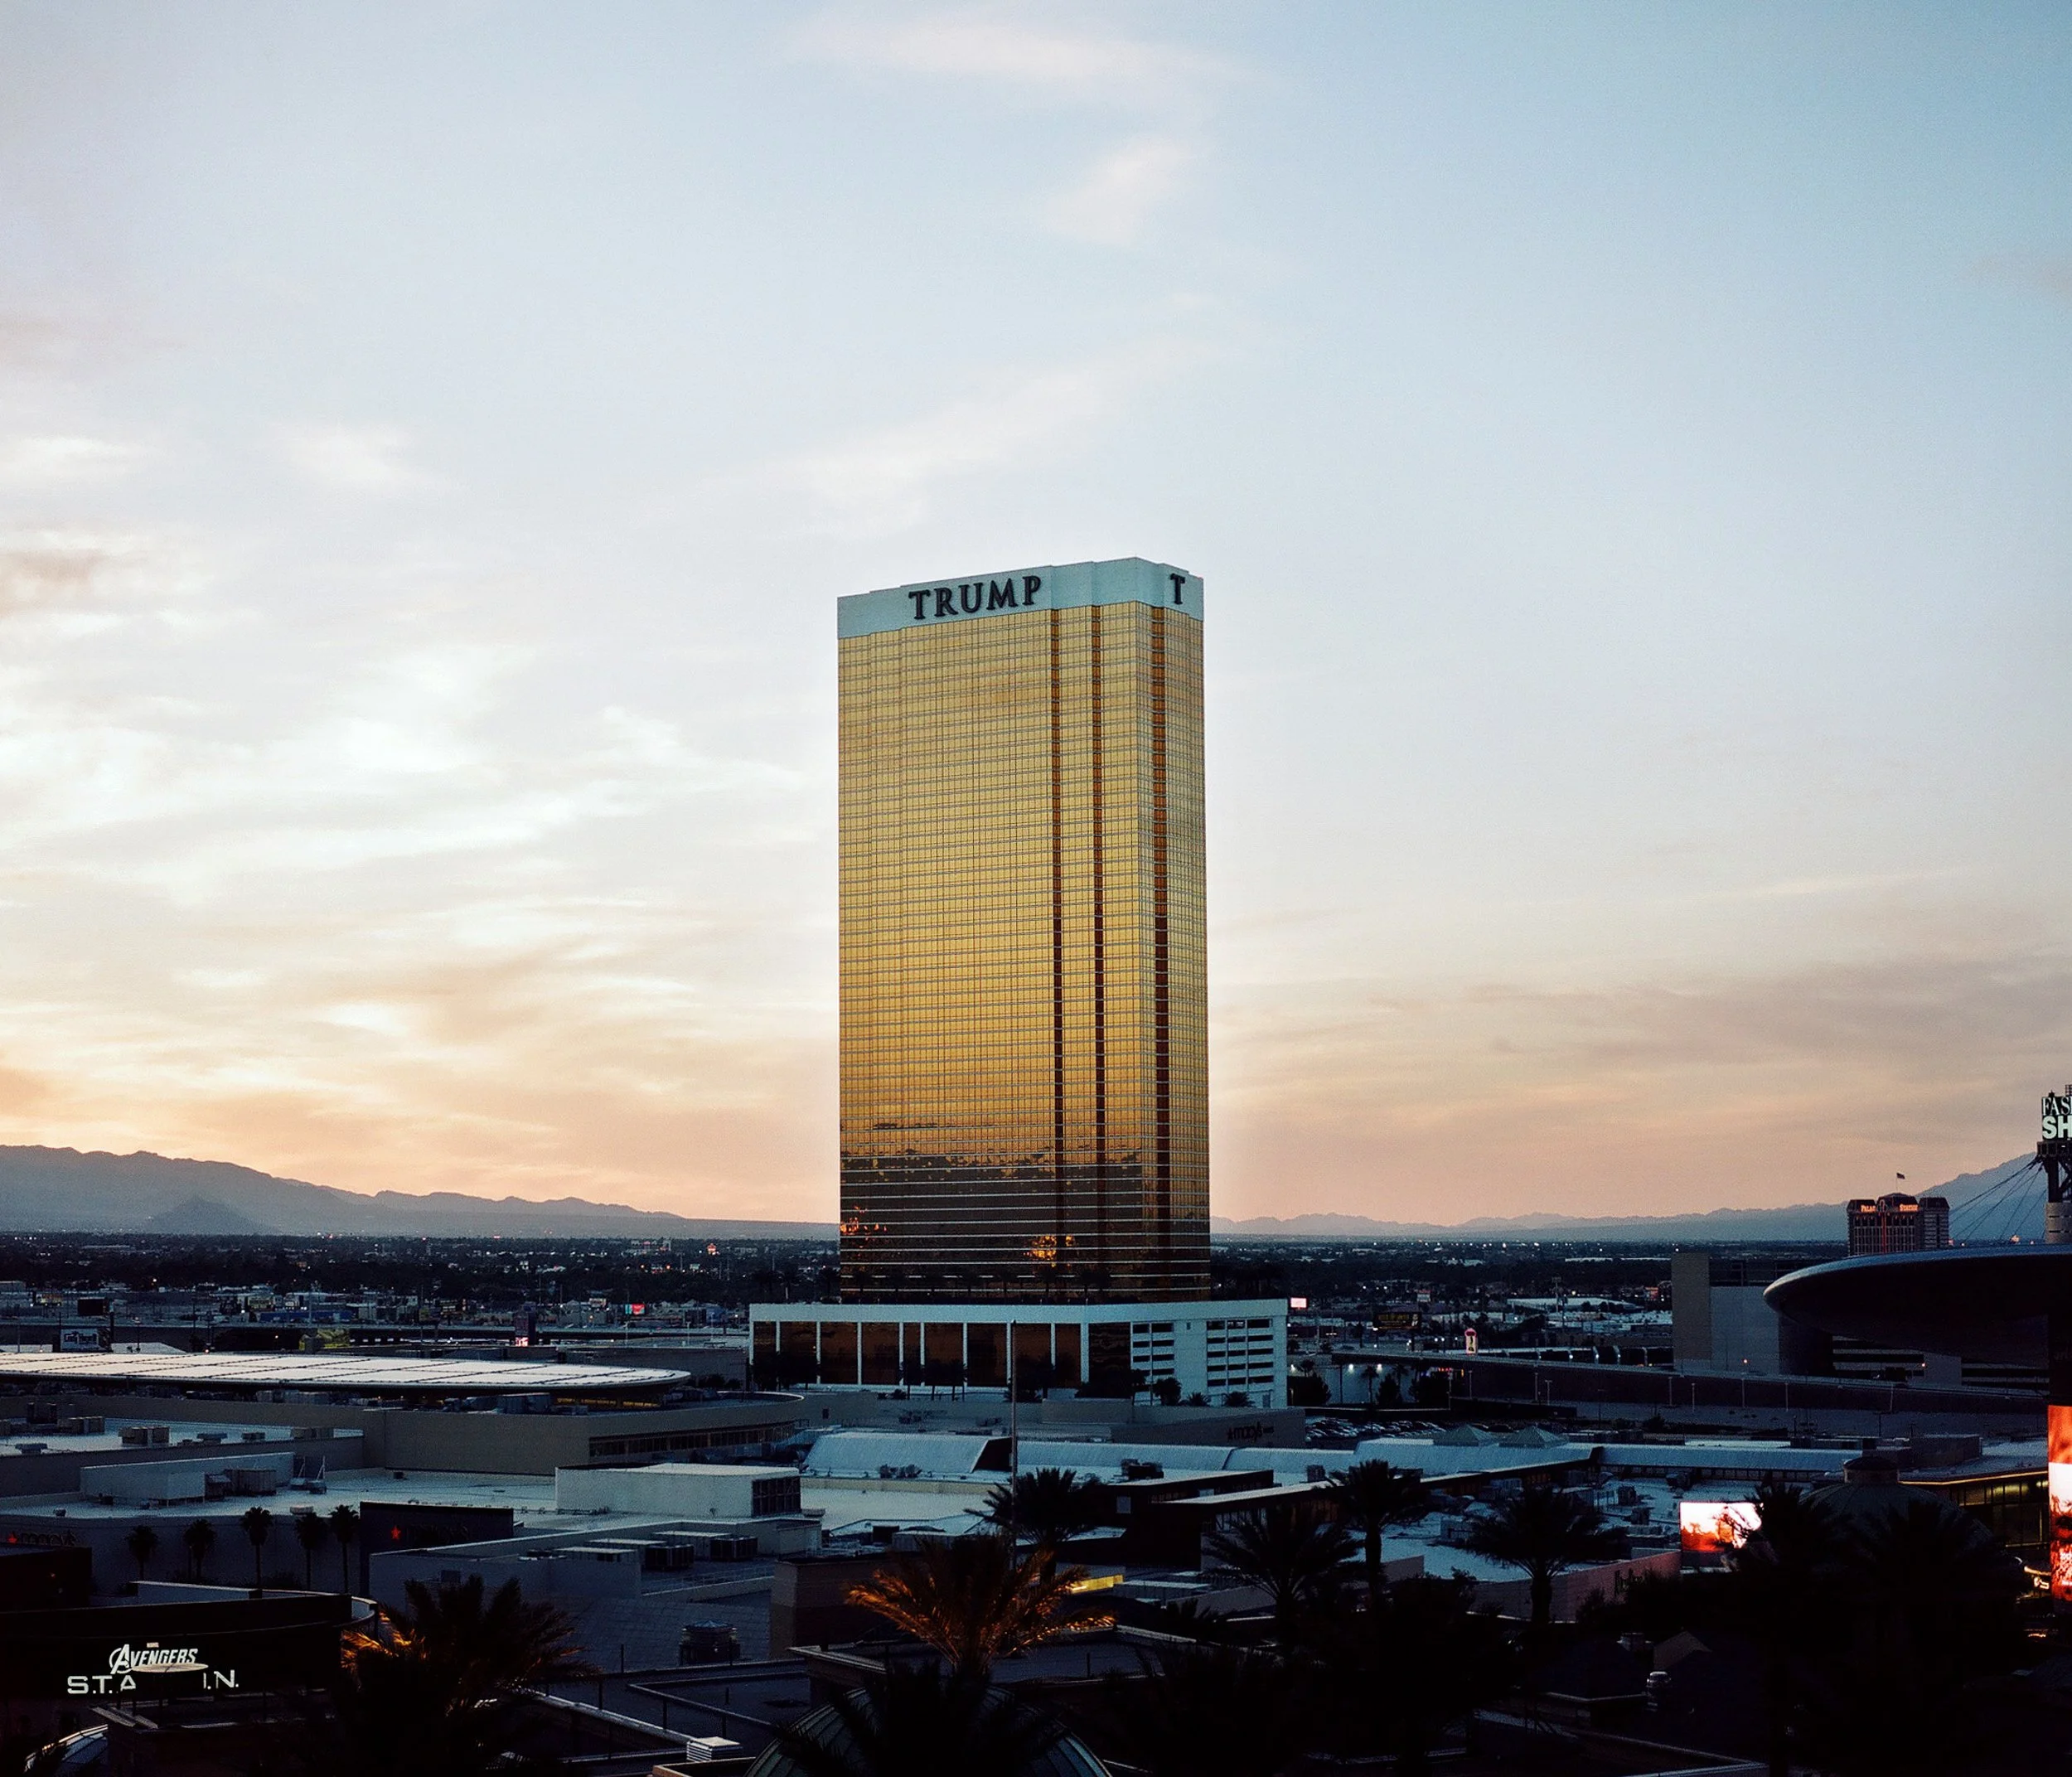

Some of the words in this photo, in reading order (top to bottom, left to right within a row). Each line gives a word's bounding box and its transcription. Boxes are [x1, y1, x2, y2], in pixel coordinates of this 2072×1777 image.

[908, 575, 1042, 620] TRUMP
[1170, 574, 1186, 605] T
[2041, 1097, 2072, 1116] FAS
[109, 1644, 198, 1674] AVENGERS
